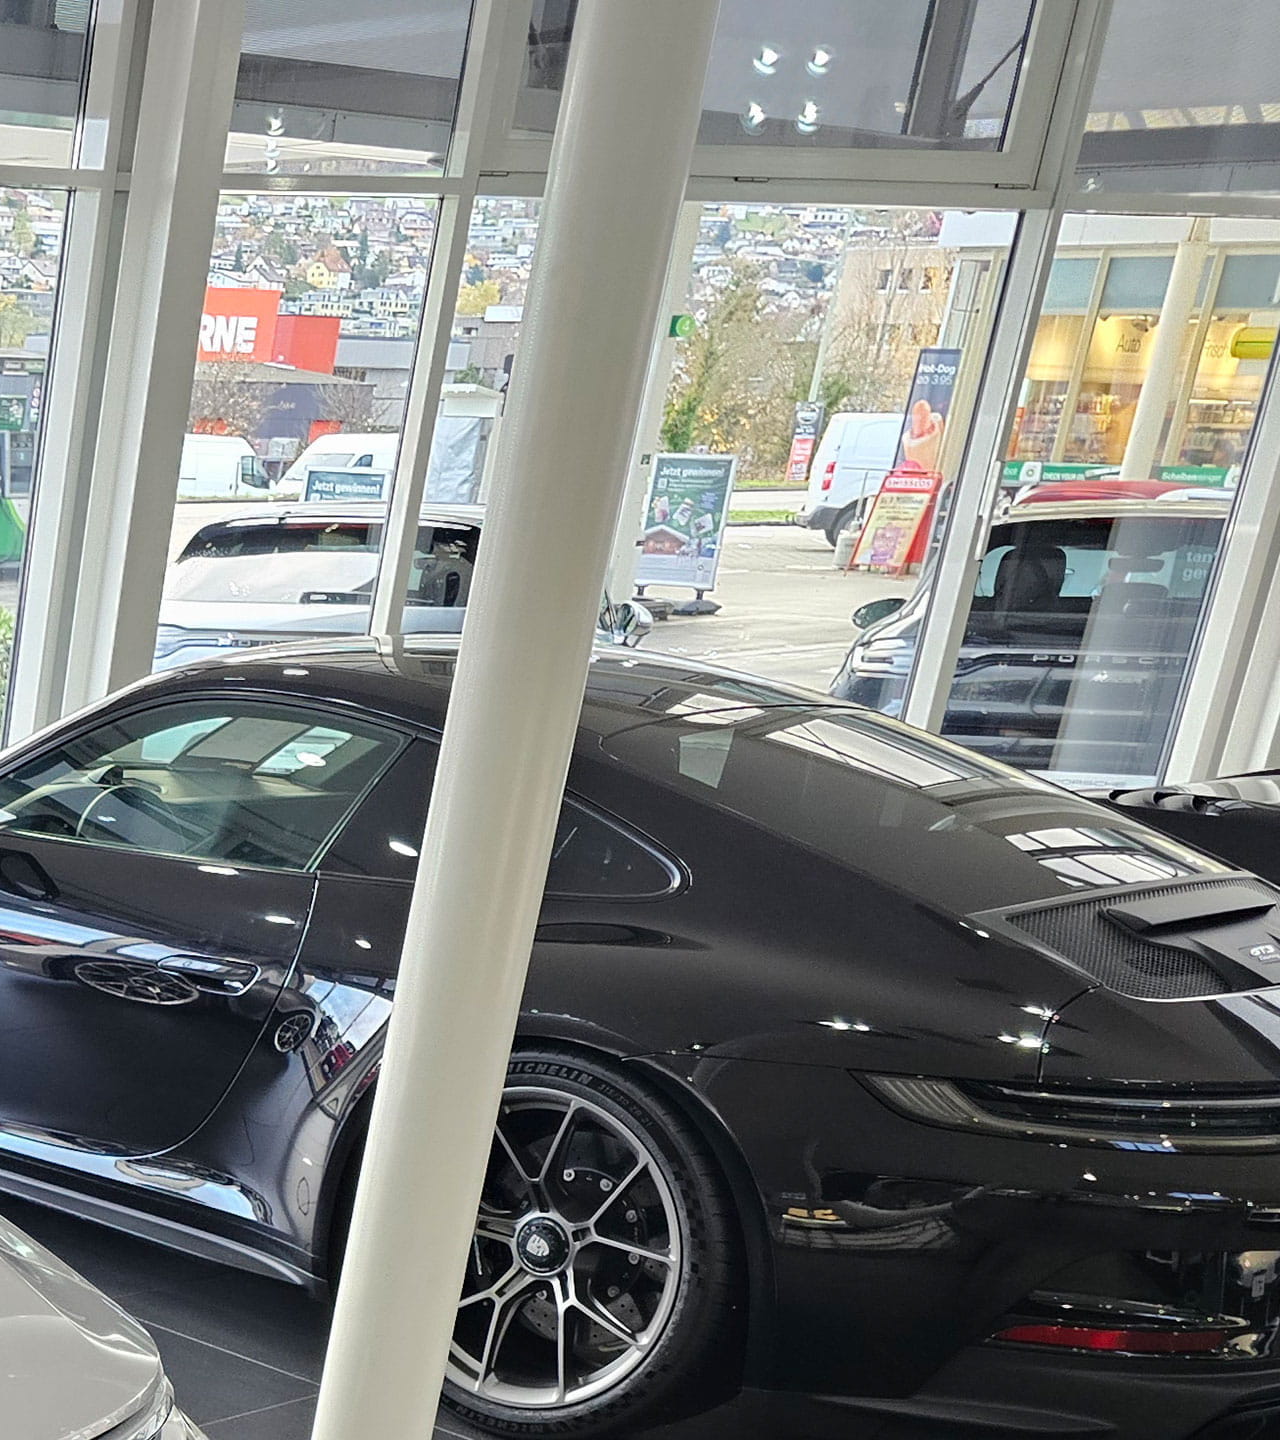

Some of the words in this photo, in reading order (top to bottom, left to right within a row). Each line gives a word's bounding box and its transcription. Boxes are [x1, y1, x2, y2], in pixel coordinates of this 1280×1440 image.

[1116, 334, 1142, 353] Auto
[660, 466, 681, 476] Jetzt
[312, 480, 335, 492] Jetzt
[335, 482, 380, 495] gewinnen!
[1186, 552, 1217, 563] tan
[1032, 654, 1181, 666] PORSCH
